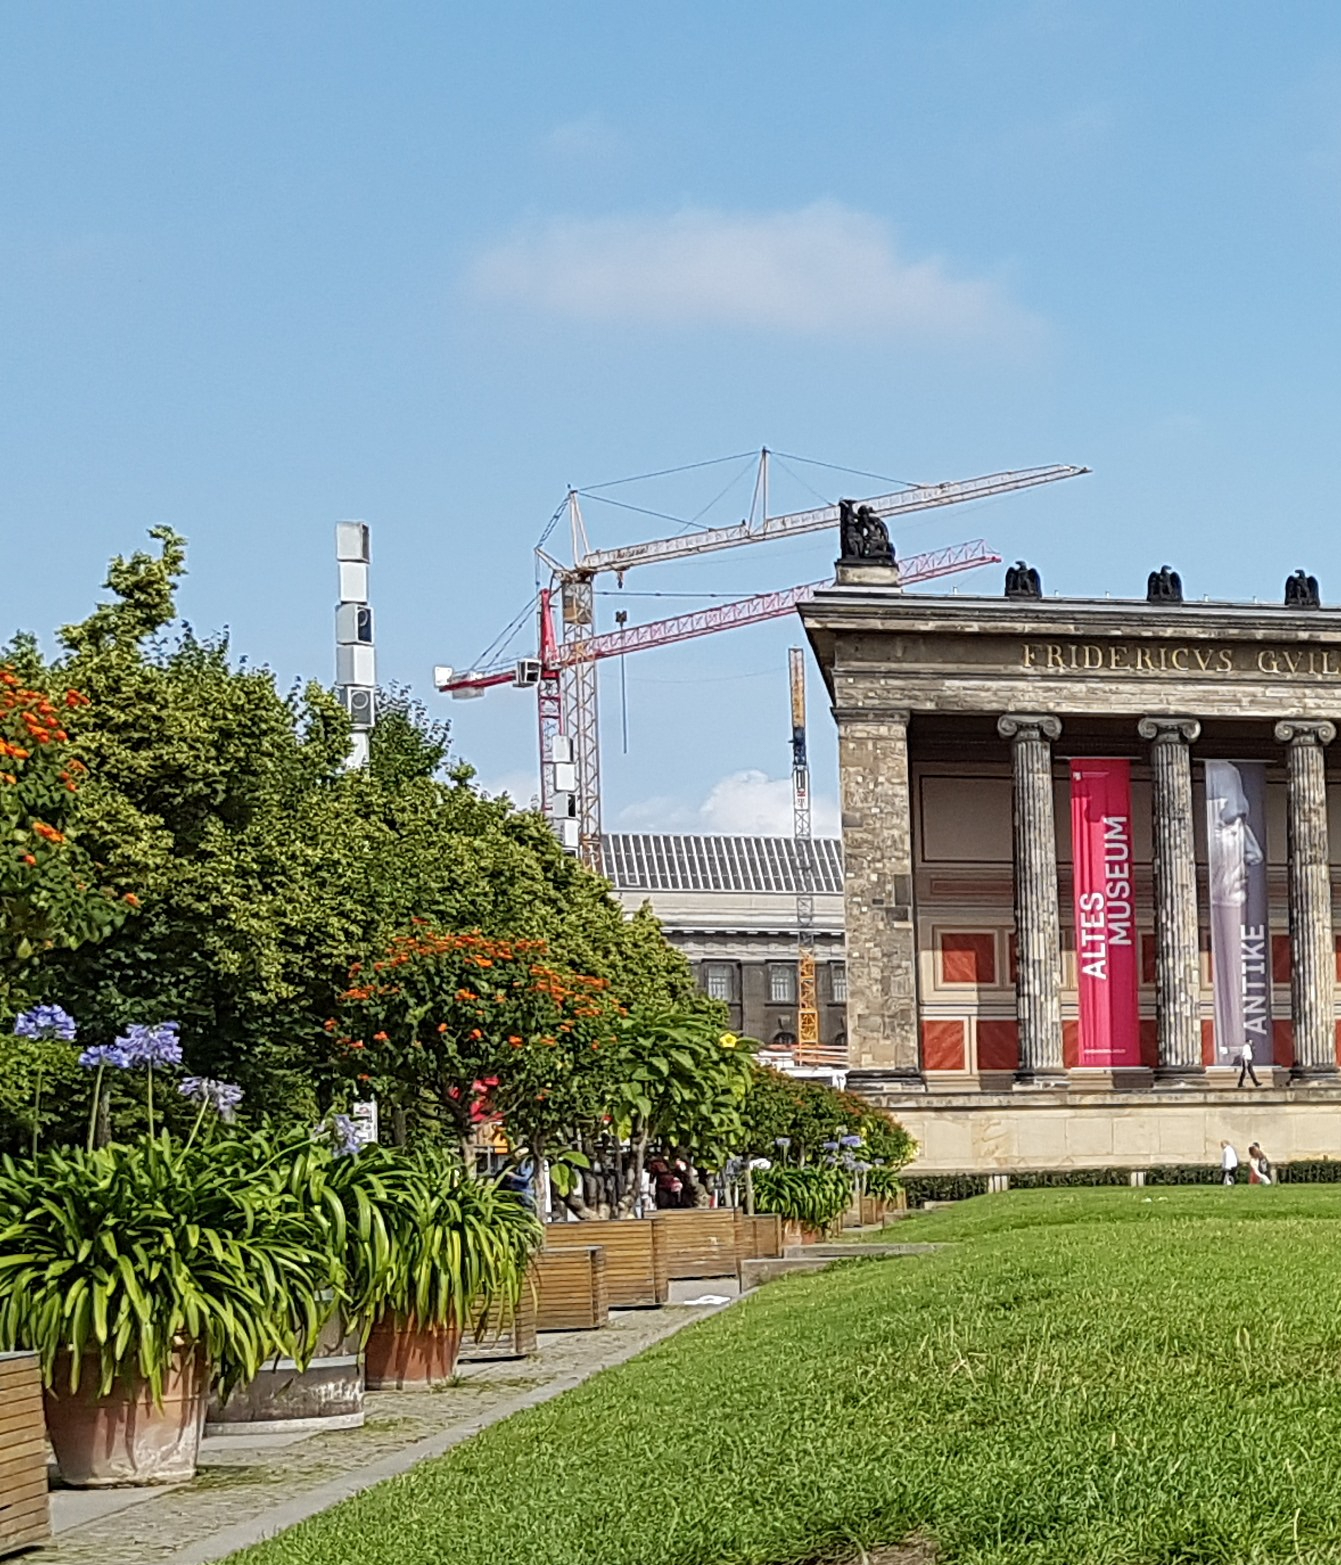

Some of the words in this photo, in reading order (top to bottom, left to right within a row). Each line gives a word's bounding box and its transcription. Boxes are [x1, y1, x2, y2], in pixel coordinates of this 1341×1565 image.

[1022, 645, 1233, 671] FRIDERICVS
[1104, 816, 1132, 945] MUSEUM
[1080, 892, 1107, 980] ALTES
[1240, 924, 1267, 1035] ANTIKE
